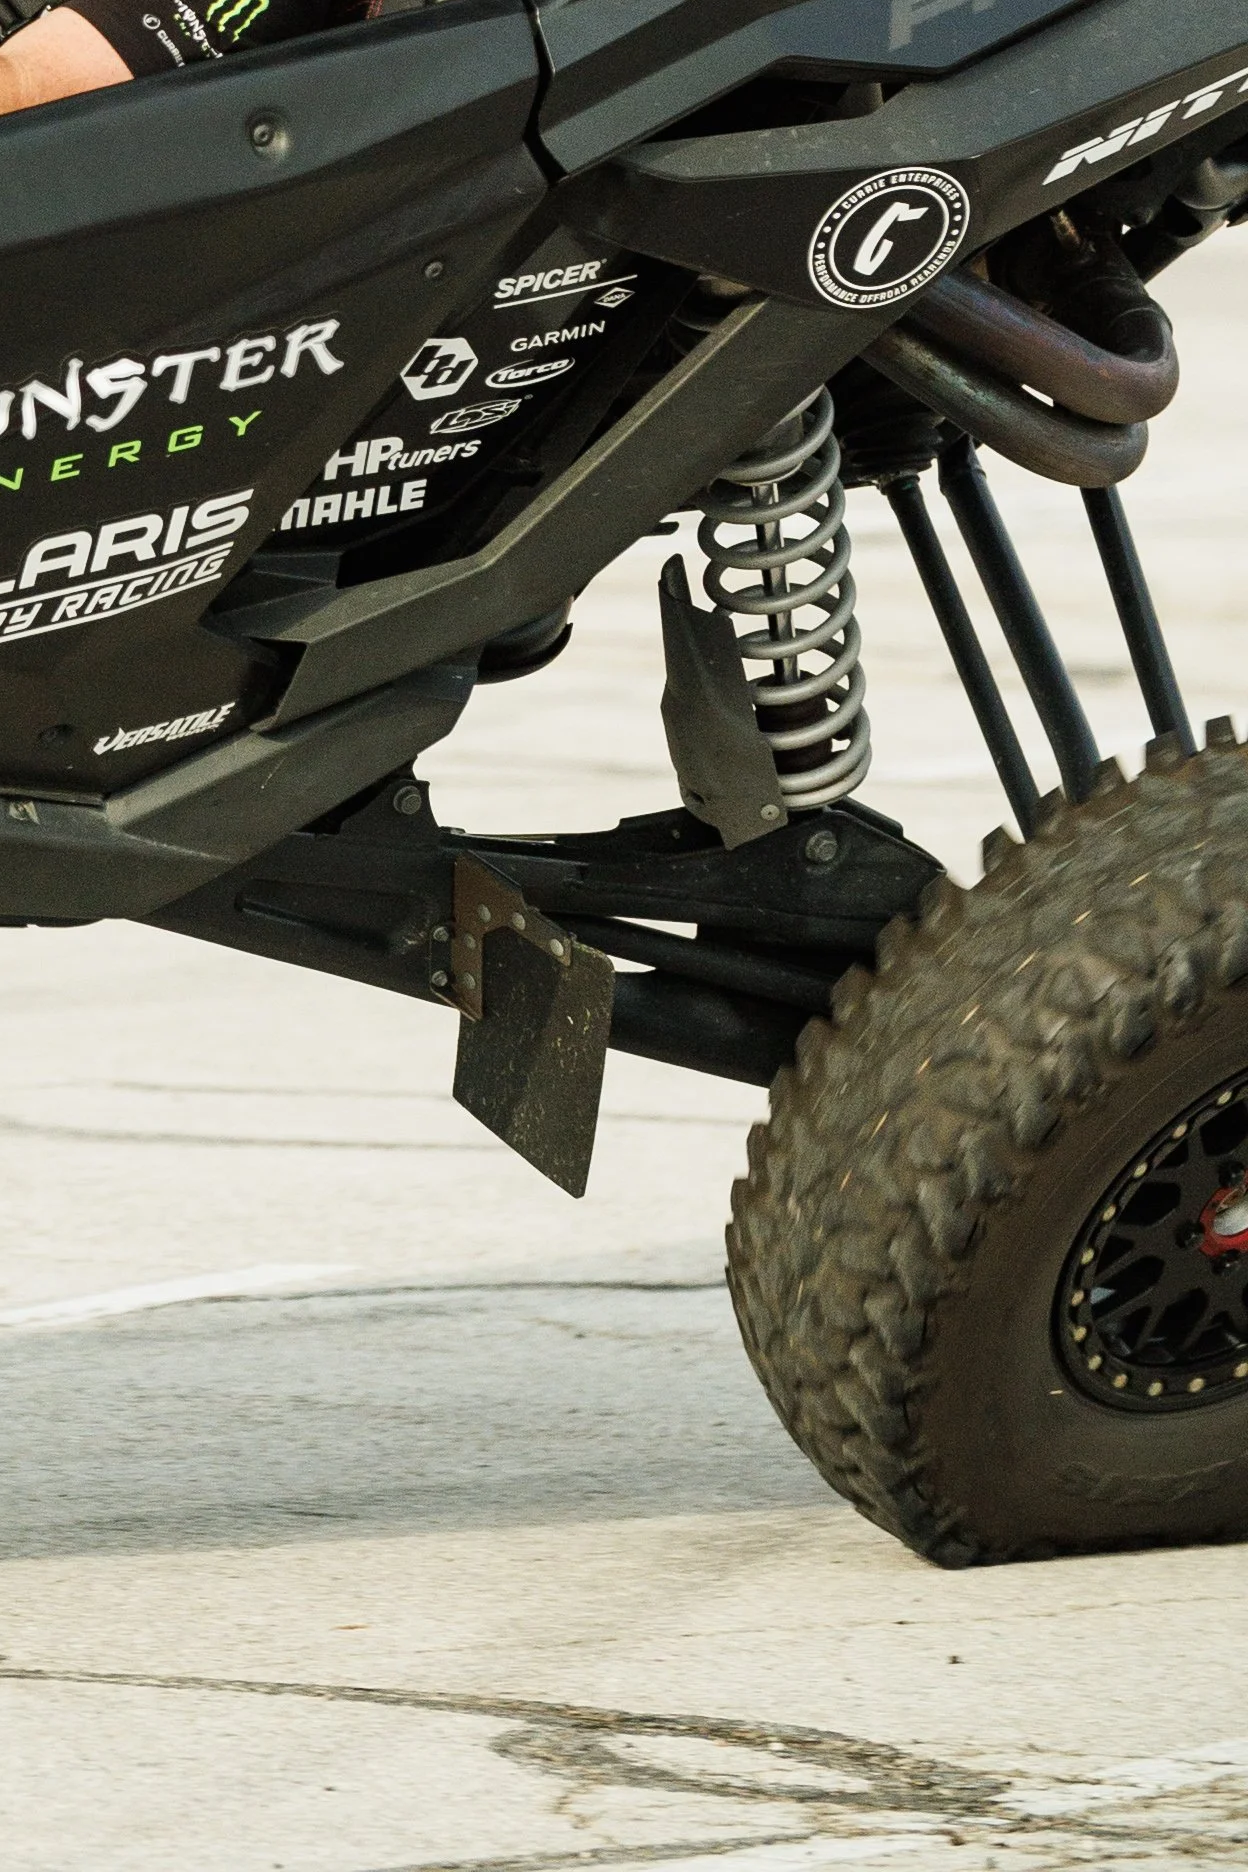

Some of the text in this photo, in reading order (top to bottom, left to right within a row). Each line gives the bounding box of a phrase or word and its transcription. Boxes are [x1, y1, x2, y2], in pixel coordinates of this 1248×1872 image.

[1041, 65, 1248, 186] NIT
[842, 172, 960, 210] CURRIE ENTERPRISES
[494, 260, 602, 299] SPICER
[814, 240, 957, 304] PERFORMANCE OFFROAD REARENDS
[510, 320, 606, 353] GARMIN
[51, 549, 231, 624] RACING
